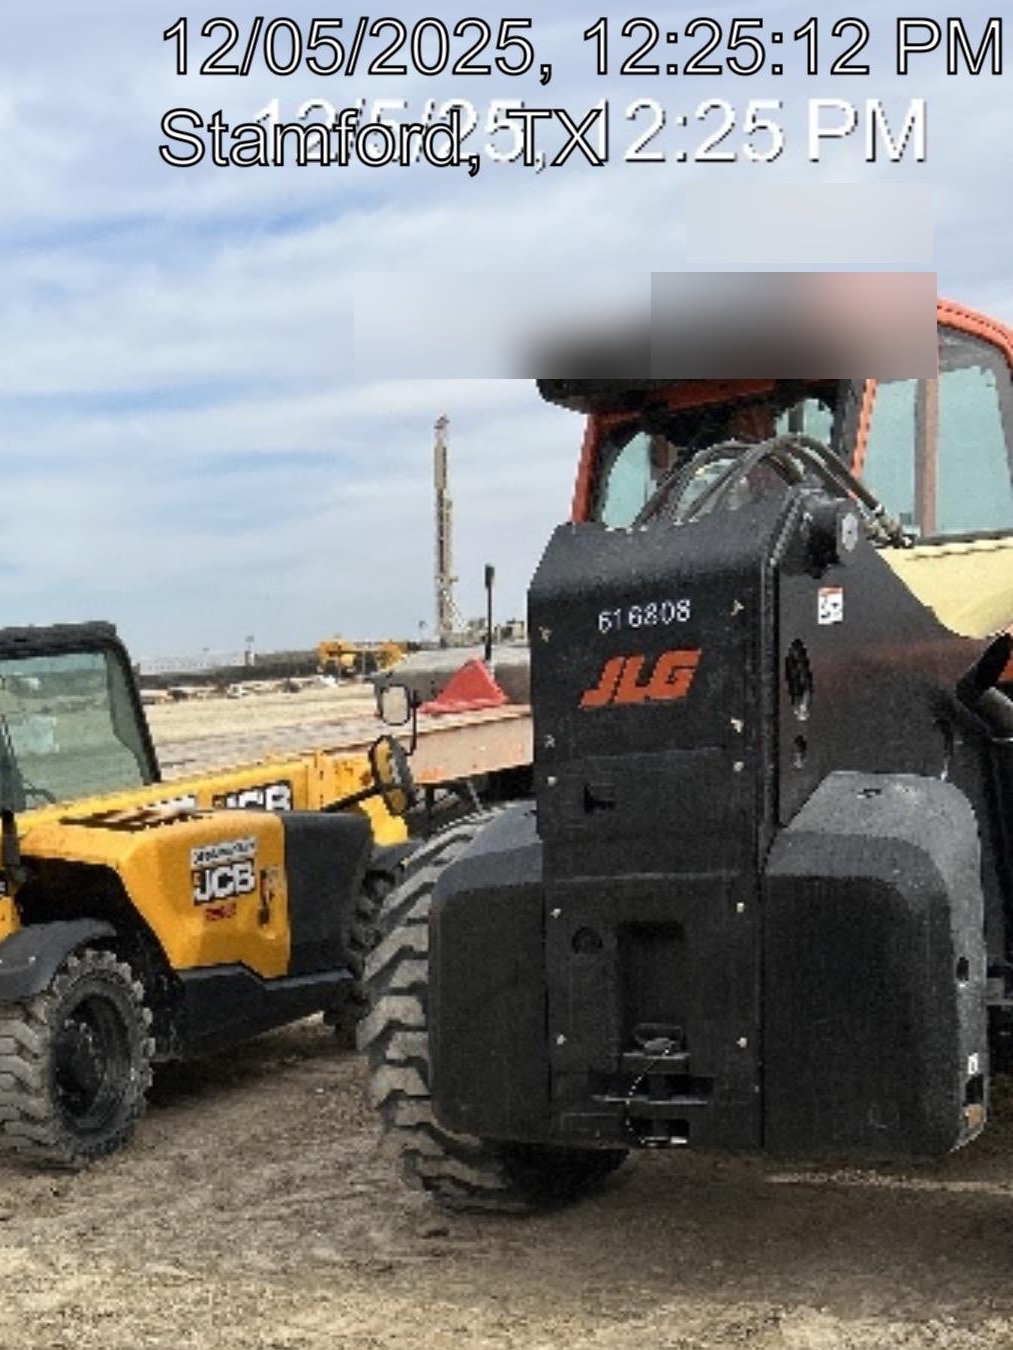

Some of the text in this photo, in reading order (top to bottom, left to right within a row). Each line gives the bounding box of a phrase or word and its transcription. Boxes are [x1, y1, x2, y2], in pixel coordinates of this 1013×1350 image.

[597, 599, 691, 634] 616808
[577, 648, 702, 710] JLG
[194, 862, 256, 901] JCB
